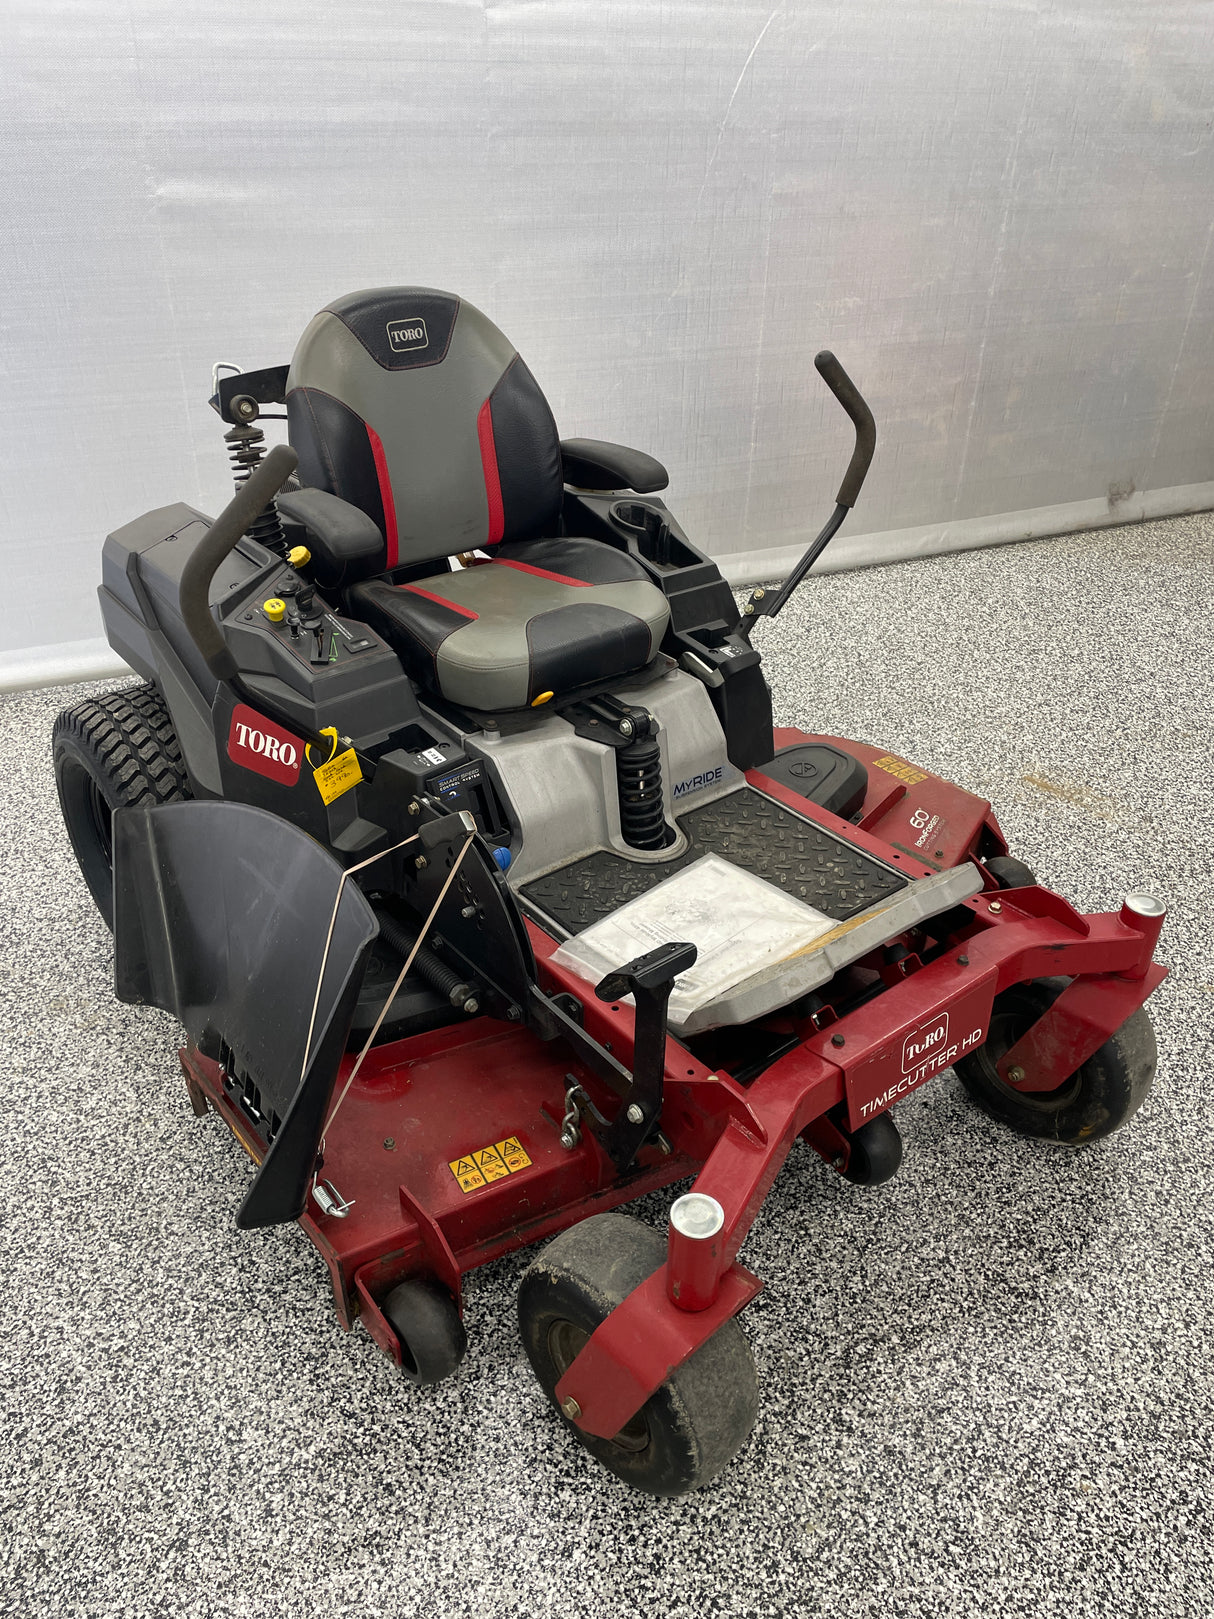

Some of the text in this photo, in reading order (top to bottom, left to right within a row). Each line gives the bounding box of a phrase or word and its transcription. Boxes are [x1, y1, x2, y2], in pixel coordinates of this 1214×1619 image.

[391, 327, 423, 343] TORO
[235, 722, 297, 766] TORO
[439, 768, 479, 787] SMART SPEED
[439, 773, 480, 792] CONTROL SYSTEM
[860, 1028, 982, 1118] TIMECUTTER HD
